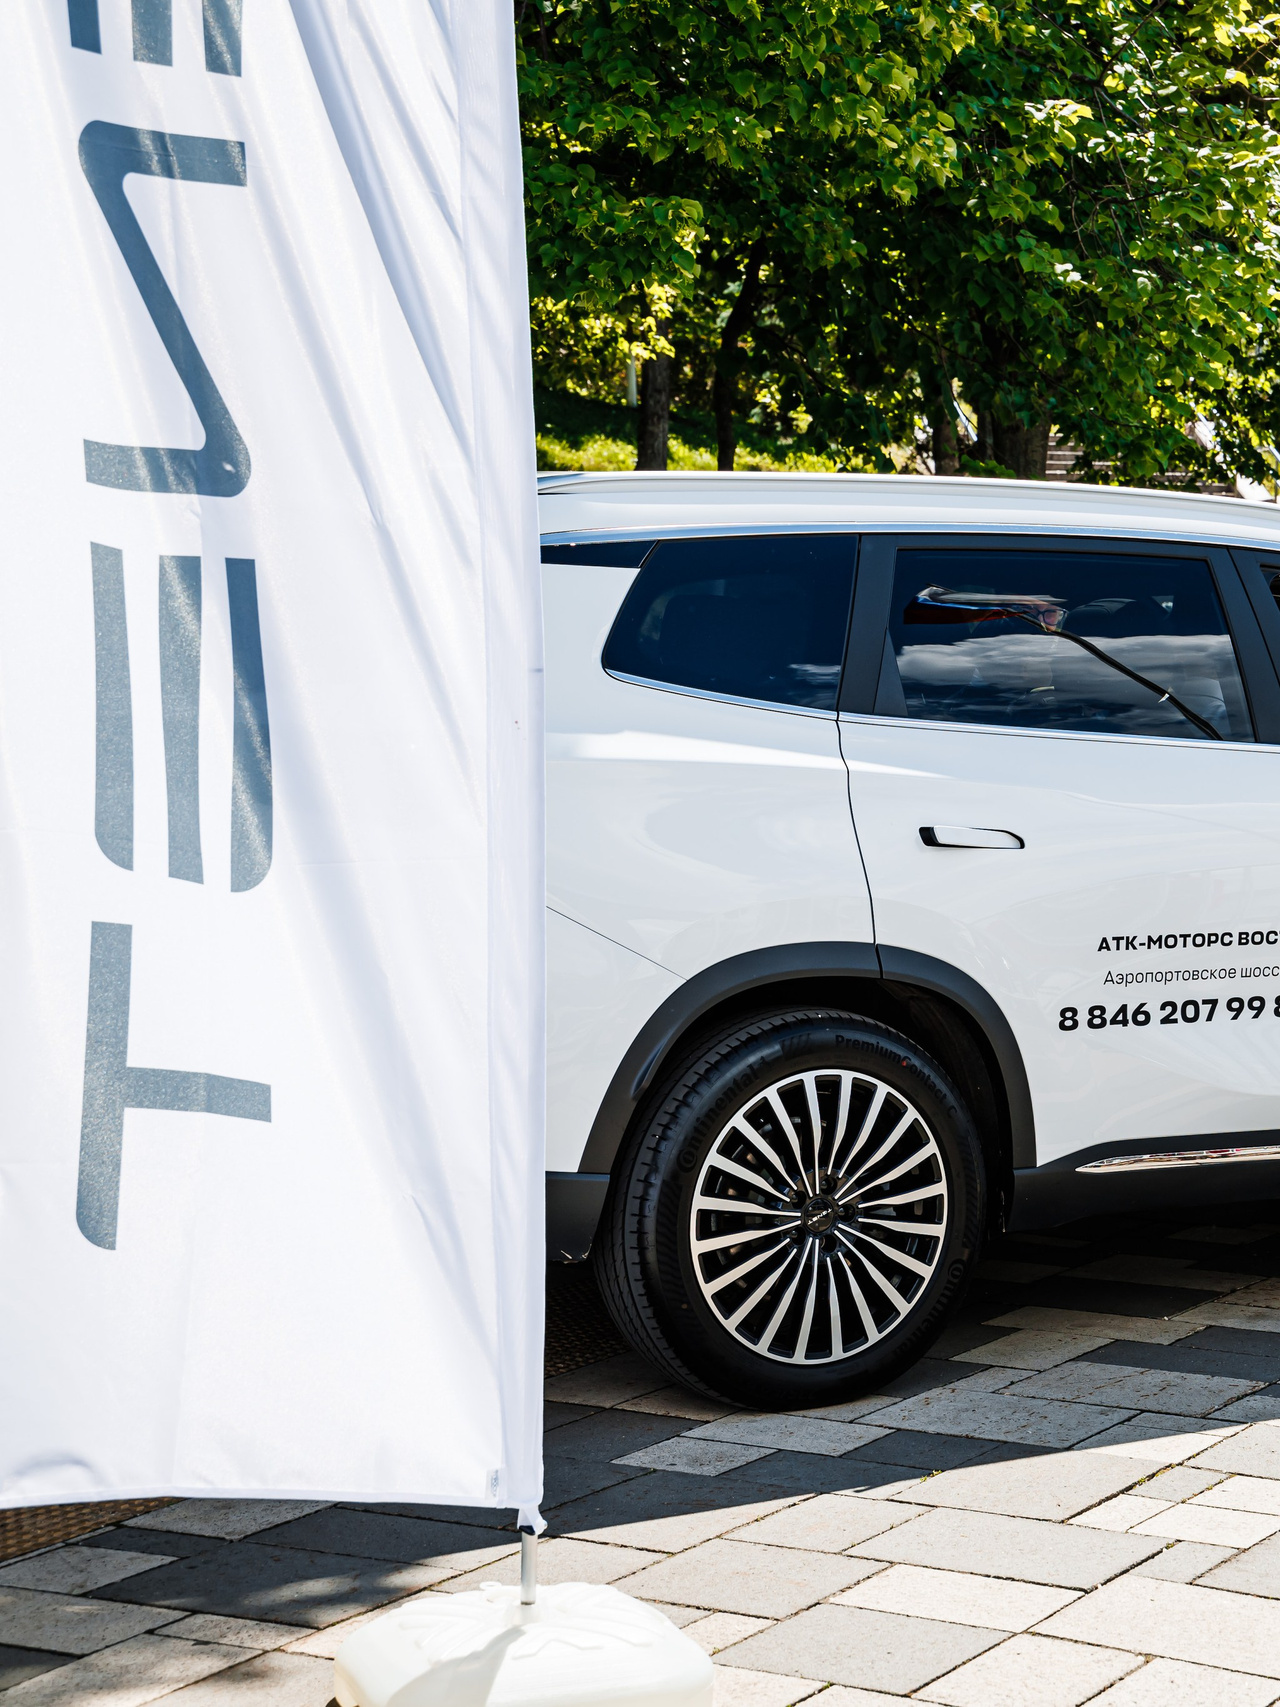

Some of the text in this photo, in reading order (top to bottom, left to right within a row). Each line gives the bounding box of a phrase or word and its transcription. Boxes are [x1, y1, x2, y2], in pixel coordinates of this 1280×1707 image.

[68, 0, 275, 1252] TEN
[1096, 933, 1234, 952] АТК-МОТОРС
[1103, 967, 1237, 988] Аэропортовское
[1058, 1006, 1079, 1032] 8
[1086, 1002, 1152, 1030] 846
[1159, 998, 1219, 1025] 207
[1225, 995, 1266, 1021] 99
[834, 1033, 949, 1106] PremiumContact
[675, 1065, 762, 1175] Continental
